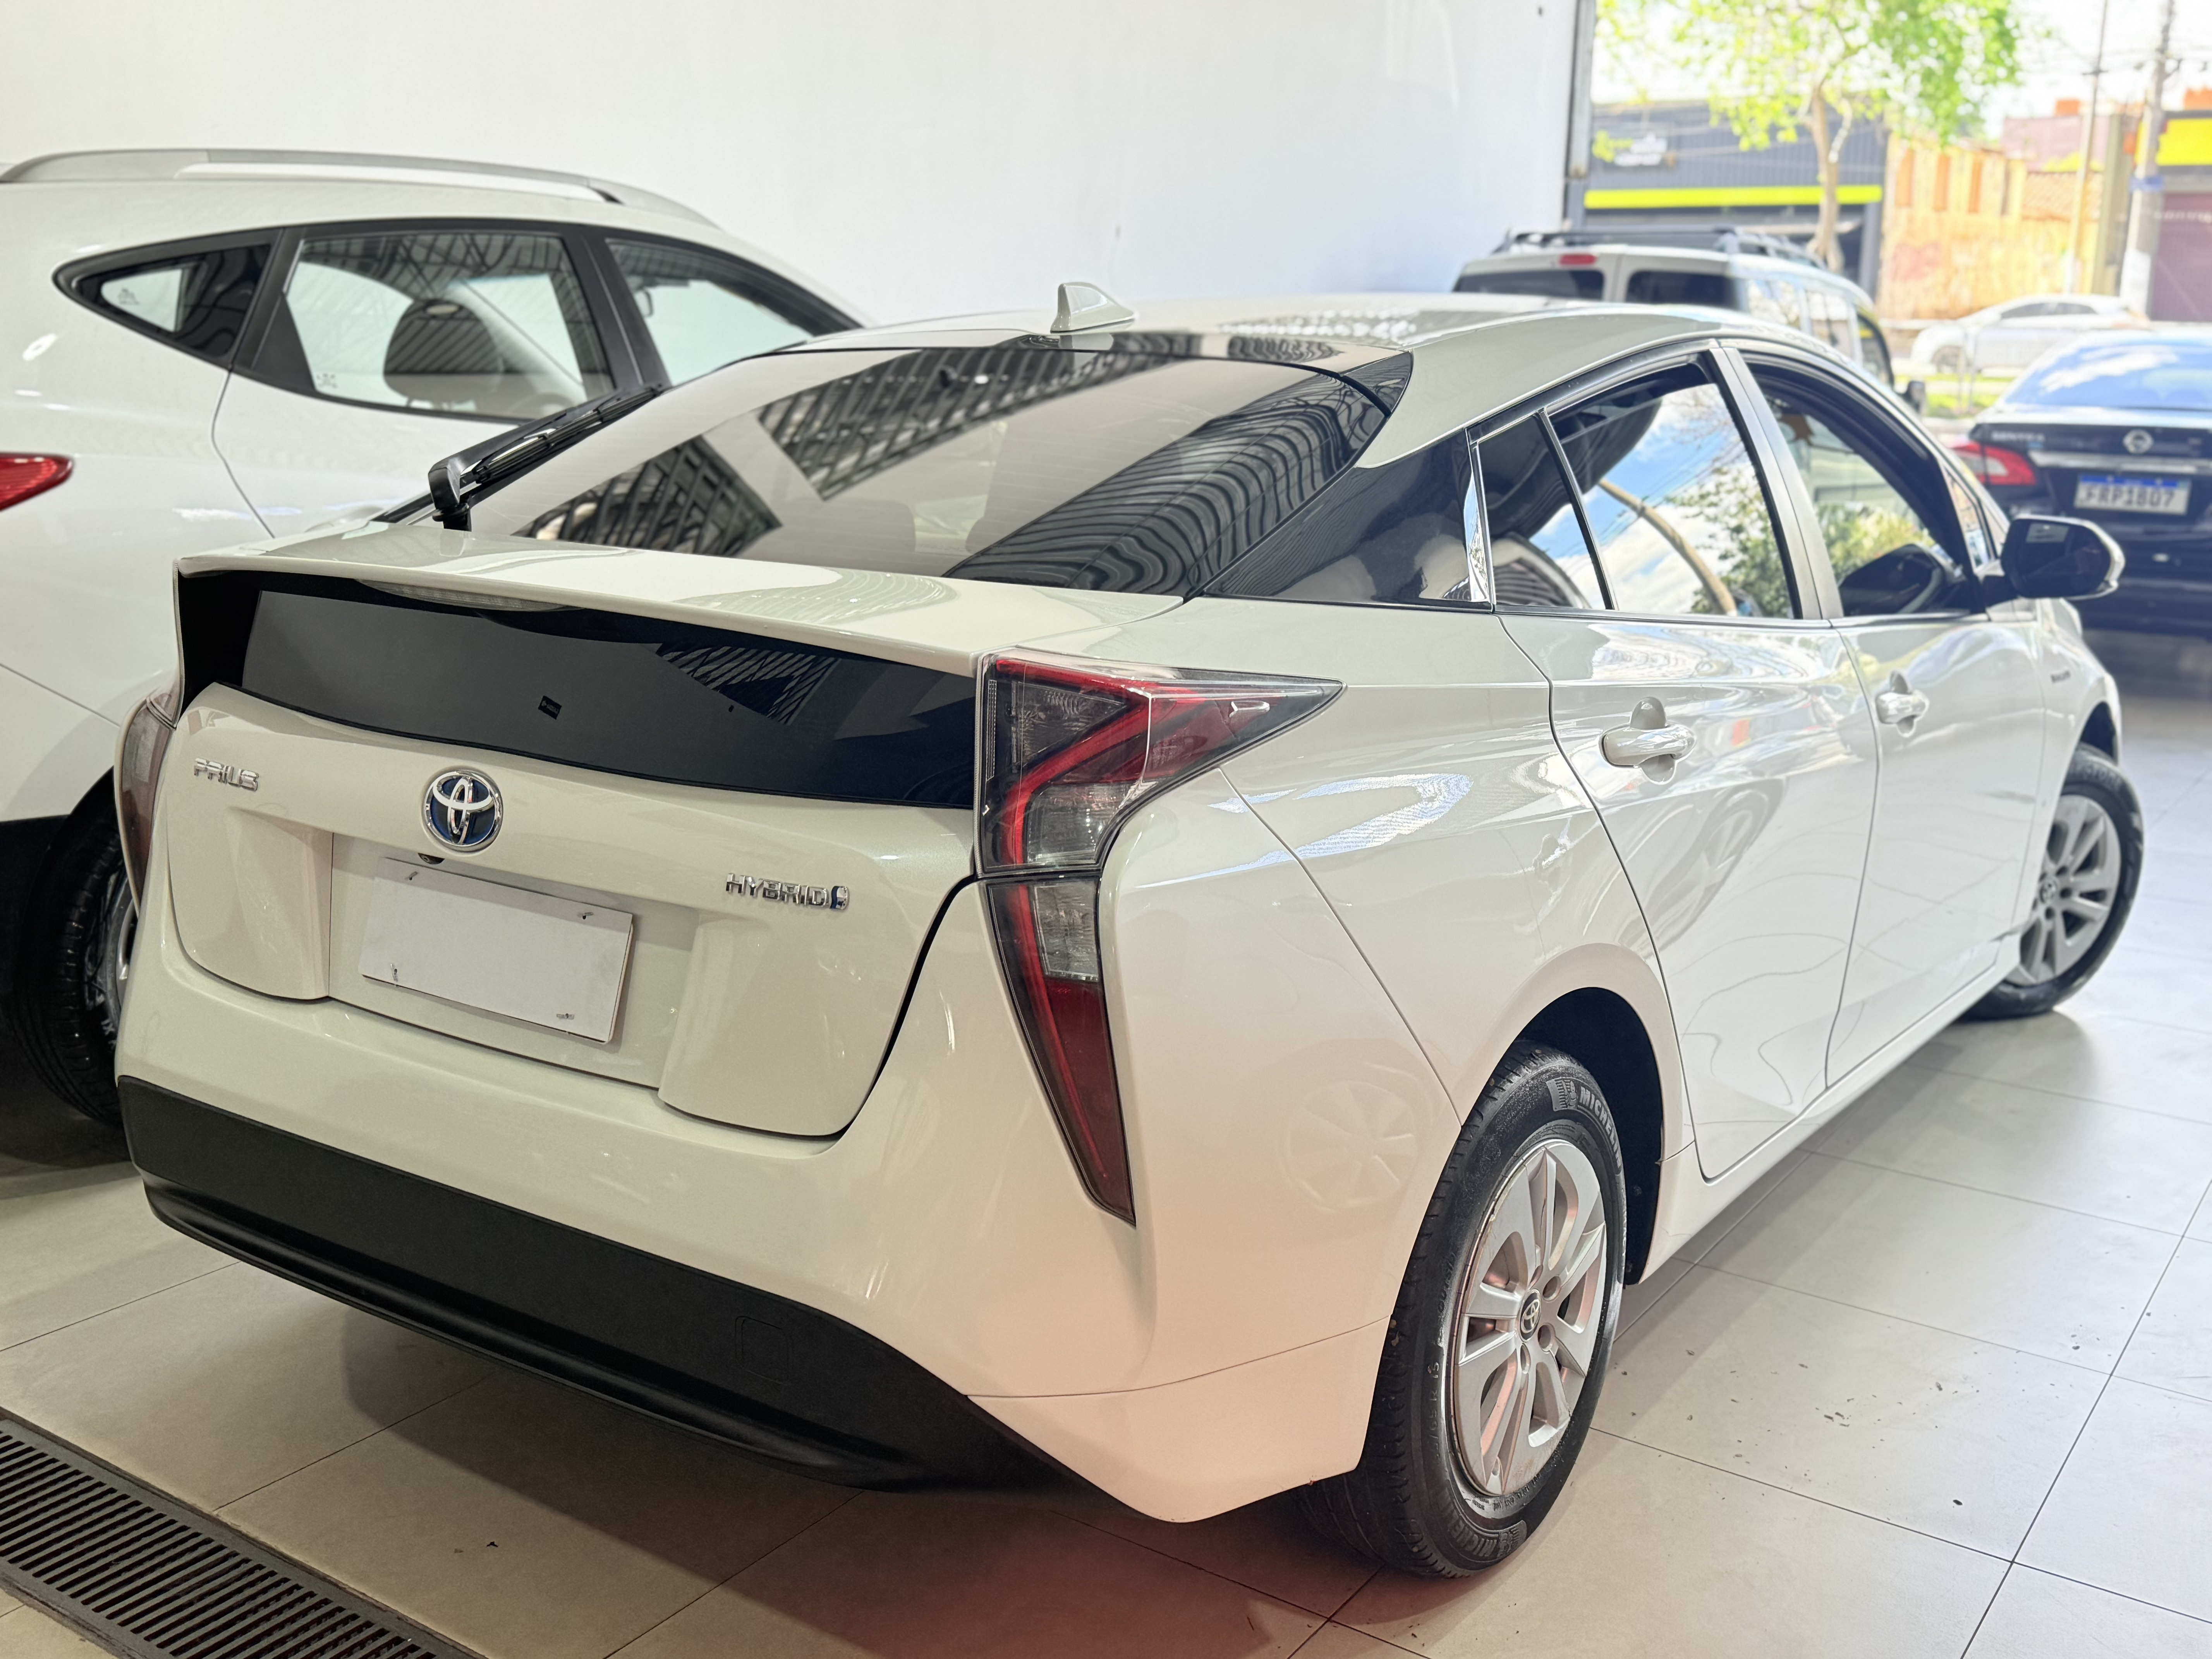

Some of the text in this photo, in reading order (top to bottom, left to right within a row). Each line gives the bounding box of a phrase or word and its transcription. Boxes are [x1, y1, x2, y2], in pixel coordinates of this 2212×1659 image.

[194, 757, 259, 791] PRIUS
[725, 873, 830, 907] HYBRID
[1579, 1085, 1622, 1169] MICHELIN
